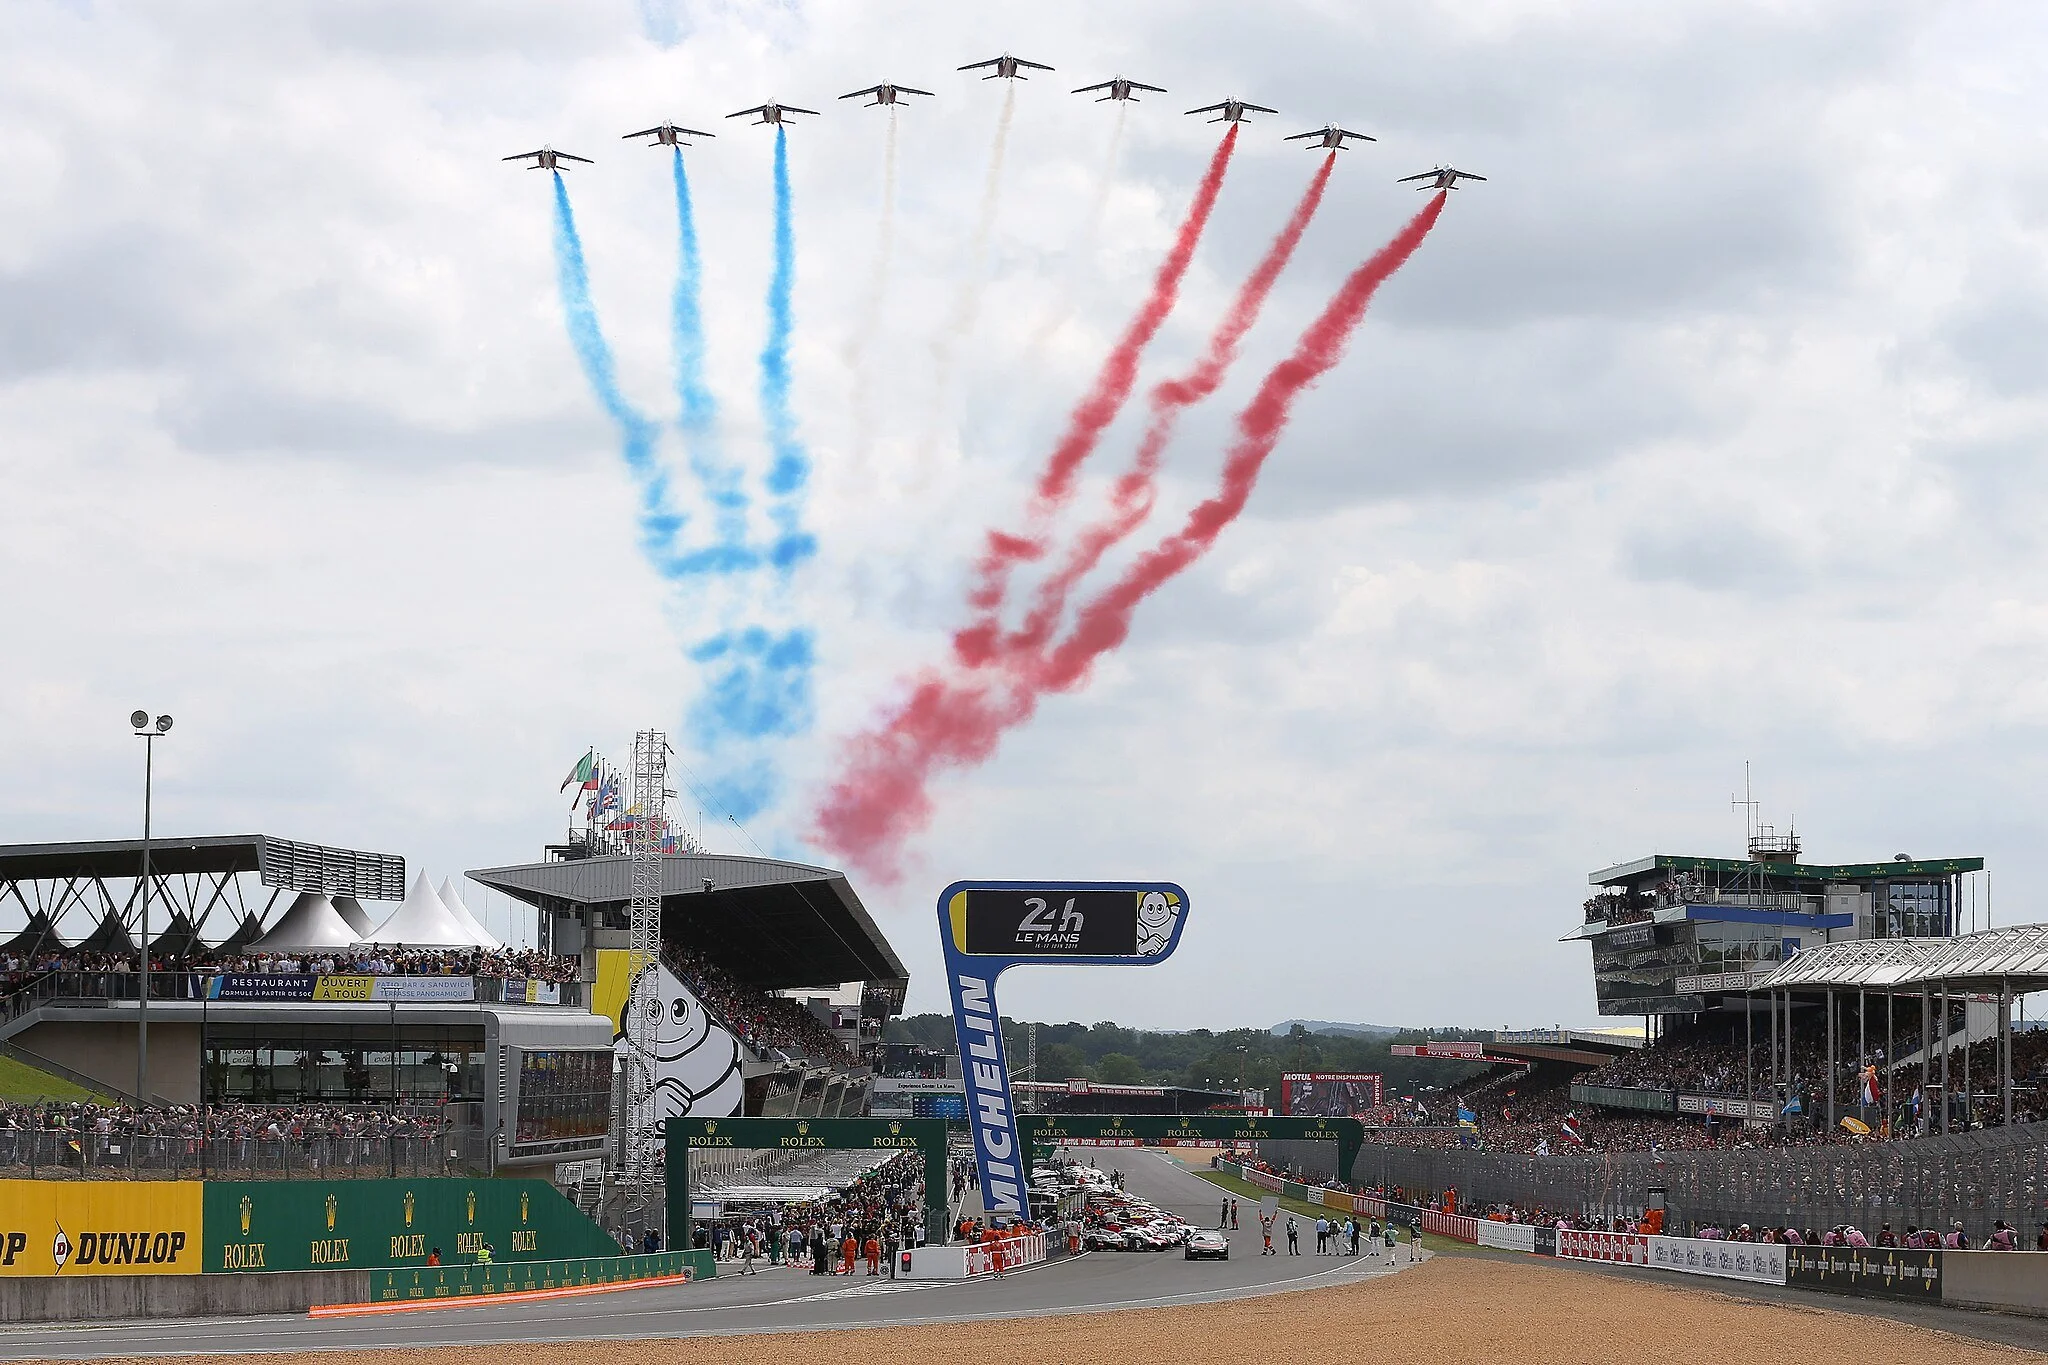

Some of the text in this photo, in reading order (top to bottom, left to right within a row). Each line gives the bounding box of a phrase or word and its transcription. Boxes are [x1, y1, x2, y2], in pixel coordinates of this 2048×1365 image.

[1015, 933, 1080, 943] LE MANS
[232, 978, 309, 987] RESTAURANT
[321, 978, 369, 988] OUVERT
[402, 981, 417, 989] BAR
[430, 981, 470, 989] SANDWICH
[323, 987, 367, 999] À TOUS
[380, 990, 467, 998] TERRASSE PANORAMIQUE
[1460, 1052, 1487, 1060] TOTAL
[1283, 1073, 1312, 1081] MOTUL
[1069, 1080, 1089, 1093] MOTUL
[958, 973, 1024, 1223] MICHELIN
[1033, 1128, 1068, 1137] ROLEX
[1100, 1128, 1134, 1137] ROLEX
[1167, 1129, 1202, 1138] ROLEX
[1234, 1129, 1269, 1138] ROLEX
[1304, 1130, 1339, 1139] ROLEX
[688, 1136, 733, 1146] ROLEX
[780, 1136, 825, 1147] ROLEX
[872, 1137, 918, 1147] ROLEX
[390, 1234, 426, 1258] ROLEX
[456, 1232, 484, 1254] ROLEX
[511, 1230, 537, 1252] ROLEX
[0, 1231, 186, 1266] P D DUNLOP
[311, 1239, 350, 1264] ROLEX
[223, 1243, 266, 1269] ROLEX
